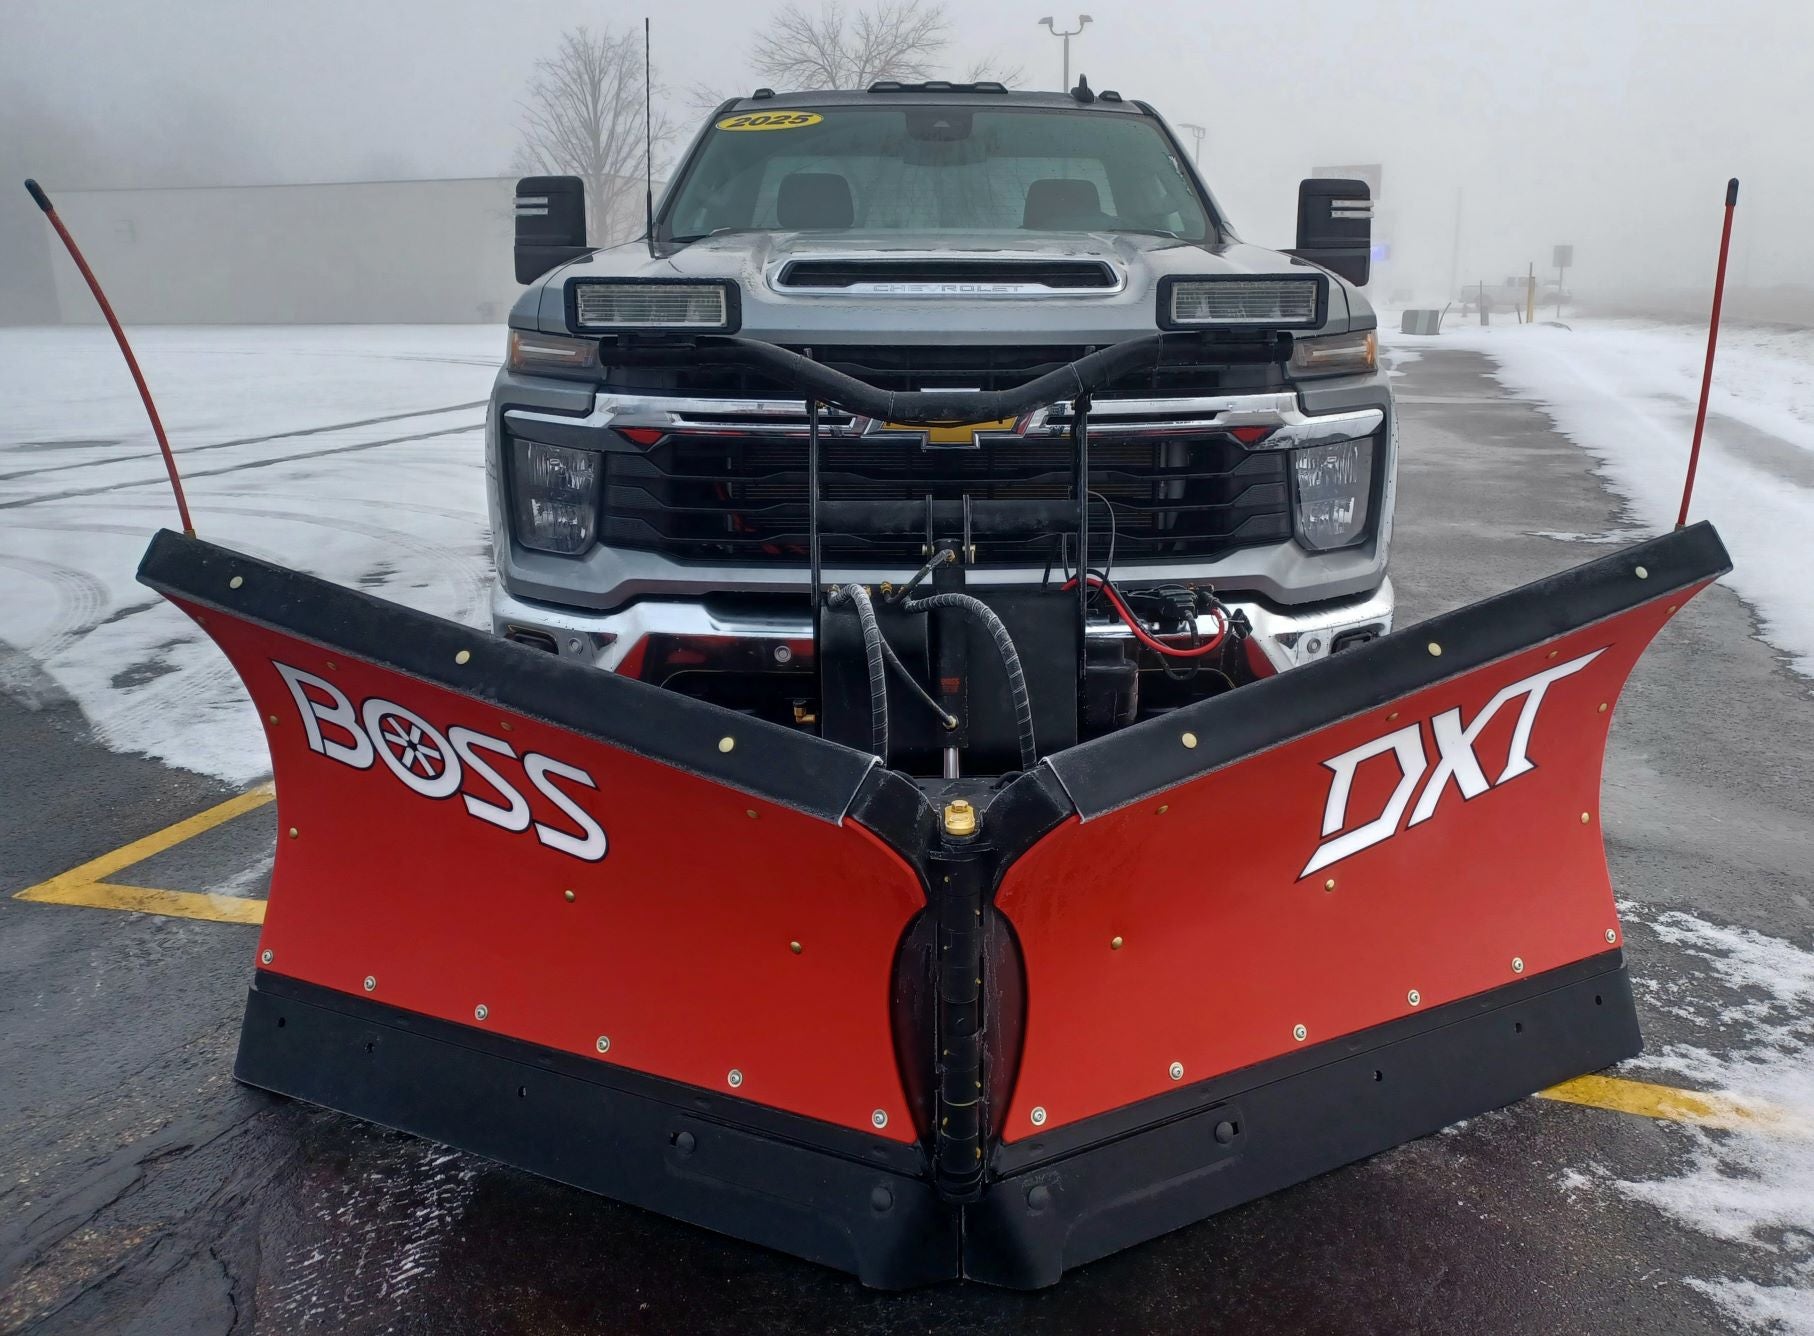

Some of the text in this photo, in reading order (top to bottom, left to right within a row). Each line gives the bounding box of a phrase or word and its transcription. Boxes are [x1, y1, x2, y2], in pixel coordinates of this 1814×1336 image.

[727, 114, 814, 128] 2025
[873, 284, 1024, 293] CHEVROLET
[272, 659, 609, 863] BOSS
[1295, 643, 1615, 883] DXT
